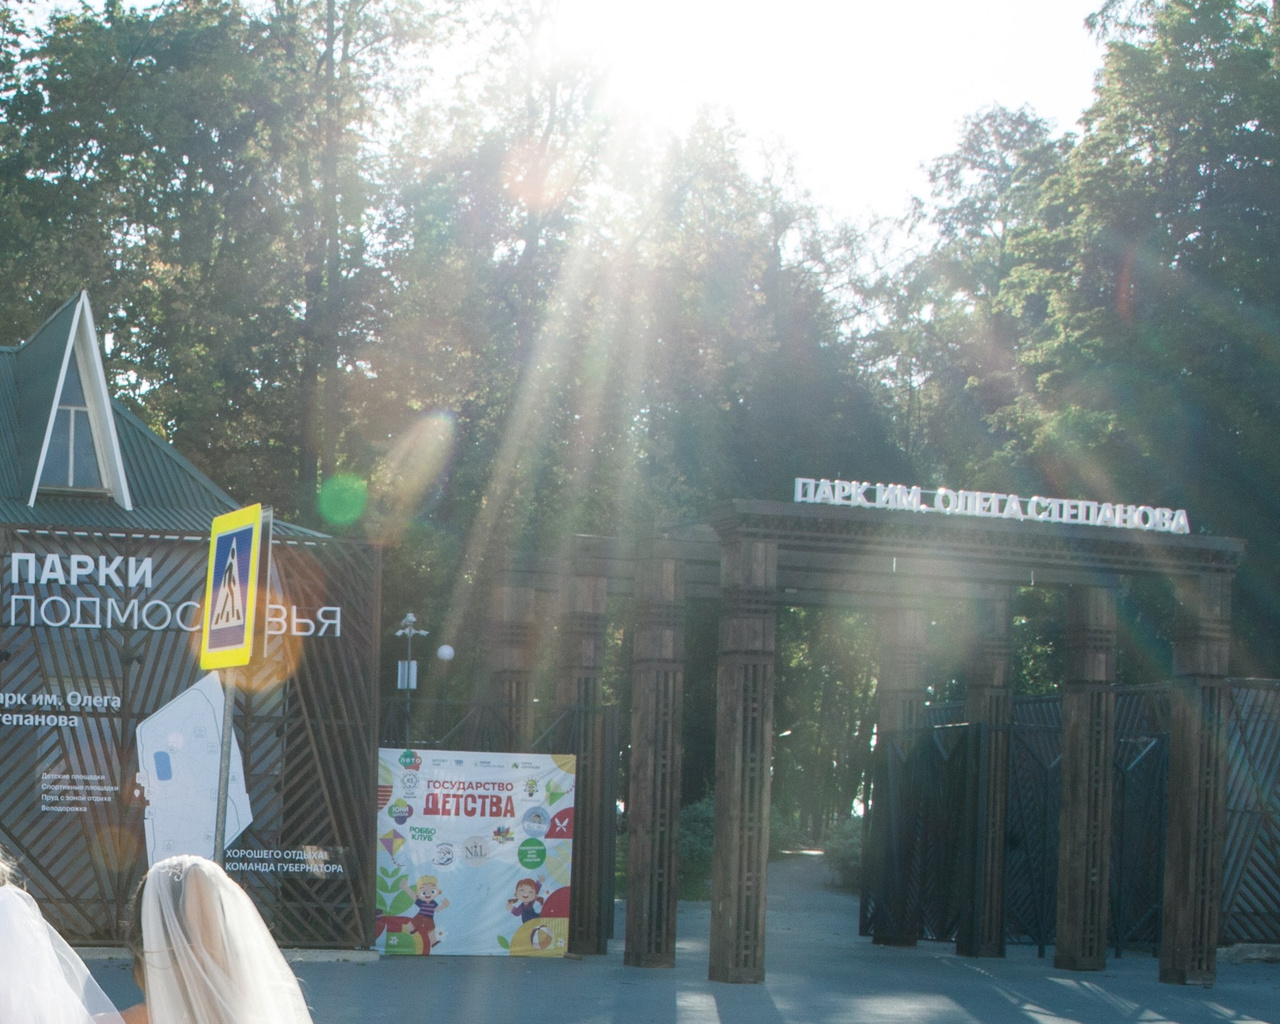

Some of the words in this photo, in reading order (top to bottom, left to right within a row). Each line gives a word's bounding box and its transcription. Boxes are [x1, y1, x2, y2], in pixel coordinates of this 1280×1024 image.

[794, 477, 872, 507] ПАРК
[875, 482, 928, 512] ИМ.
[933, 487, 1023, 519] ОЛЕГА
[1027, 495, 1191, 534] СТЕПАНОВА
[11, 552, 153, 588] ПАРКИ
[10, 595, 341, 638] ПОДМОСВЬЯ
[31, 694, 62, 706] им.
[67, 691, 122, 708] Олега
[427, 780, 514, 792] ГОСУДАРСТВО
[41, 794, 60, 802] Пруд
[423, 793, 515, 817] ДЕТСТВА
[409, 826, 437, 835] РОББО
[411, 833, 433, 841] КЛУБ
[225, 849, 282, 859] ХОРОШЕГО
[283, 850, 328, 860] ОТДЫХА!
[225, 862, 275, 872] КОМАНДА
[277, 863, 344, 873] ГУБЕРНАТОРА
